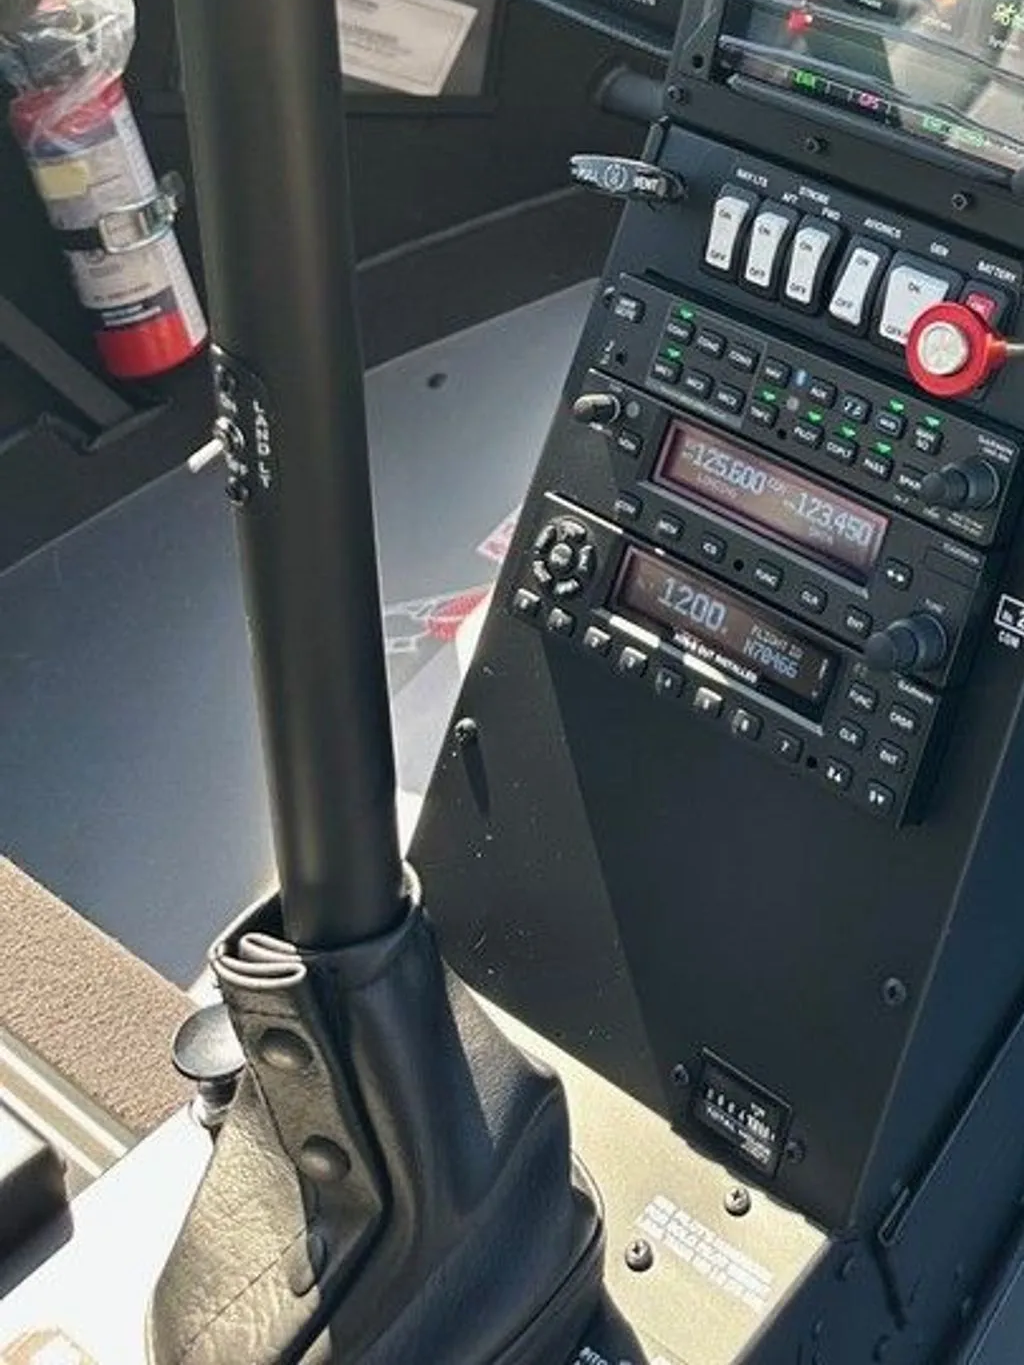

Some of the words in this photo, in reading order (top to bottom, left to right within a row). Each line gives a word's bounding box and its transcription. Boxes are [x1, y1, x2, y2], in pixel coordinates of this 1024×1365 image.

[798, 186, 831, 206] STROBE
[821, 206, 841, 221] FWD
[976, 260, 1018, 283] BATTERY
[252, 399, 271, 455] LAND
[755, 567, 777, 586] FUNC
[657, 577, 727, 633] 1200
[998, 630, 1021, 649] COM
